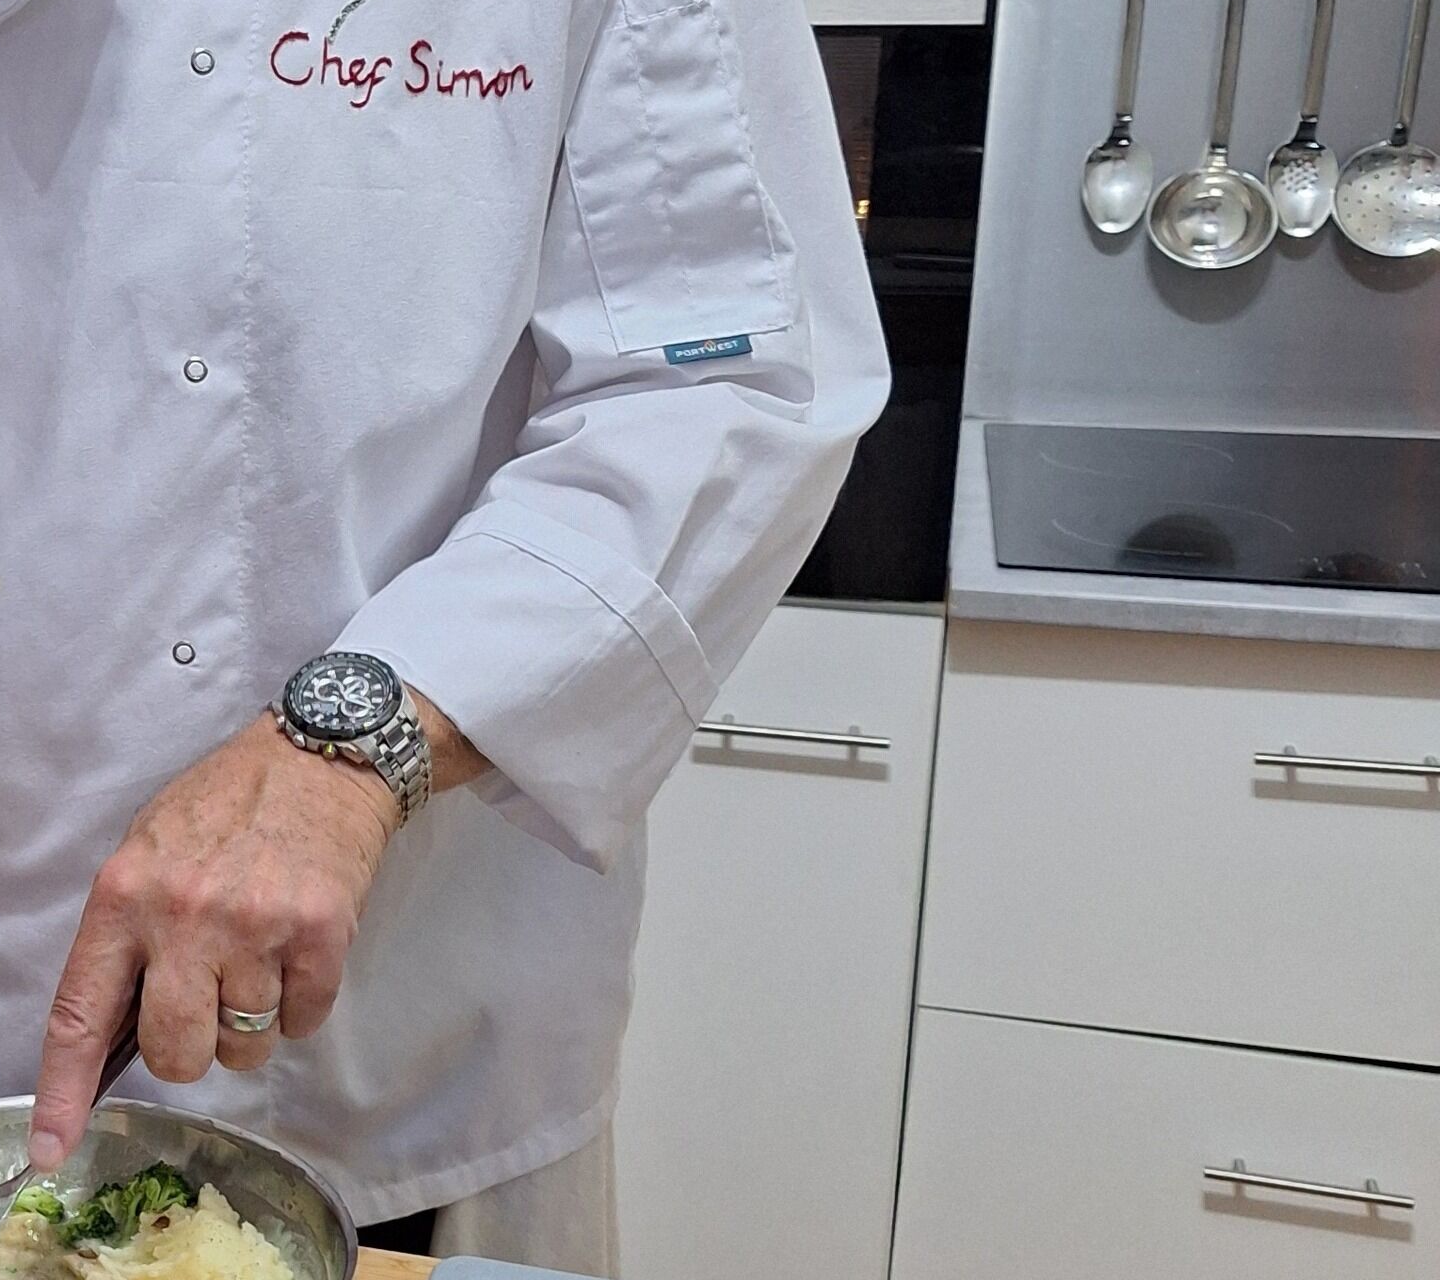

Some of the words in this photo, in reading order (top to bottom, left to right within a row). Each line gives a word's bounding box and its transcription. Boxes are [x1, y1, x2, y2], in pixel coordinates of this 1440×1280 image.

[270, 31, 393, 108] Chef
[405, 39, 534, 99] Simon
[675, 340, 739, 358] PORTWEST
